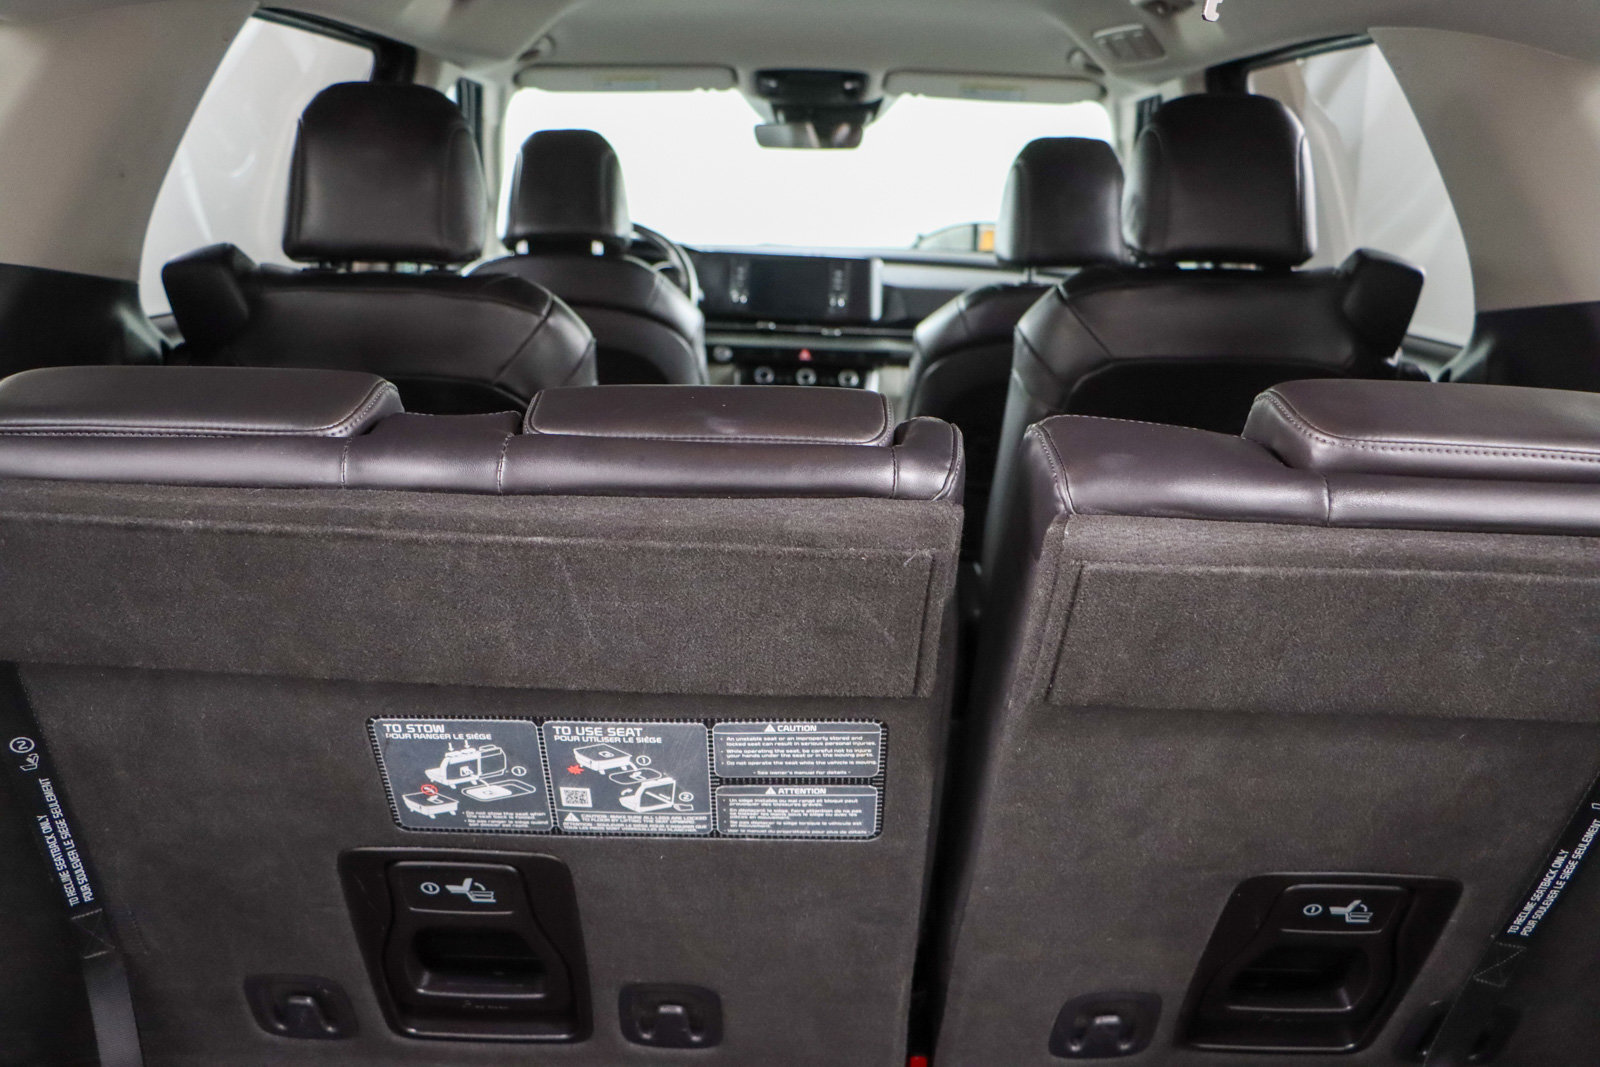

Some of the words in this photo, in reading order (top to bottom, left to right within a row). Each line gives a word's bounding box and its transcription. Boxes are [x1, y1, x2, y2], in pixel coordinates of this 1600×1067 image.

[382, 723, 402, 733] TO
[406, 724, 445, 733] STOW
[385, 732, 411, 740] POUR
[552, 726, 572, 735] TO
[575, 726, 603, 736] USE
[607, 727, 643, 737] SEAT
[777, 724, 817, 732] CAUTION
[554, 734, 580, 742] POUR
[582, 735, 621, 743] UTILISER
[38, 778, 64, 819] SEULEMENT
[778, 787, 827, 795] ATTENTION
[36, 814, 53, 834] ONLY
[44, 832, 68, 871] SEATBACK
[62, 839, 75, 850] LE
[66, 849, 88, 885] SOULEVER
[1551, 849, 1569, 869] ONLY
[58, 869, 78, 897] RECLINE
[1520, 919, 1539, 937] POUR
[1532, 889, 1560, 920] SOULEVER
[1553, 880, 1566, 890] LE
[1572, 819, 1600, 860] SEULEMENT
[1530, 868, 1559, 902] SEATBACK
[68, 896, 80, 907] TO
[80, 883, 95, 903] POUR
[1513, 901, 1537, 925] RECLINE
[1507, 924, 1520, 934] TO
